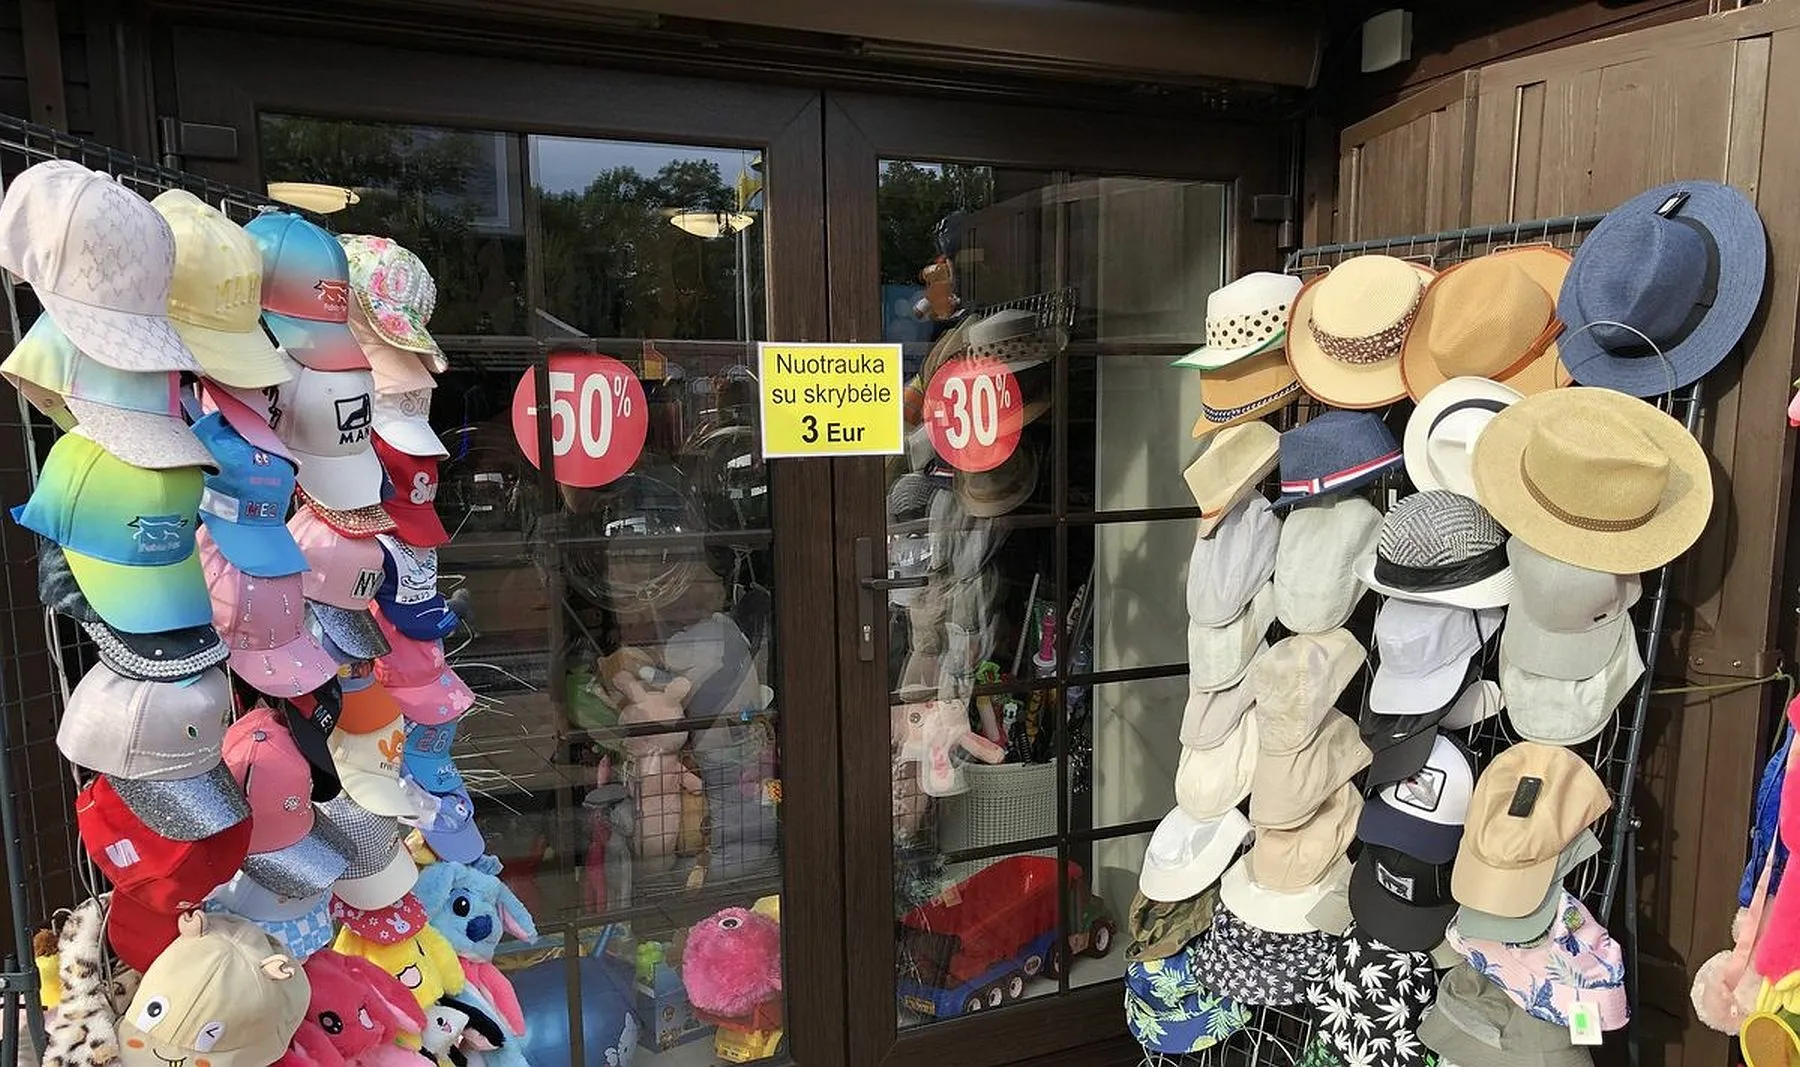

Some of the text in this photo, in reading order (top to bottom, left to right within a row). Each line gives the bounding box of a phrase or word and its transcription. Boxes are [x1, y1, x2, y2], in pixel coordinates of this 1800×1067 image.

[776, 353, 885, 374] Nuotrauka
[772, 383, 891, 409] su skrybėle
[527, 371, 632, 459] -50%
[934, 373, 1012, 450] -30%
[801, 415, 865, 444] 3 Eur
